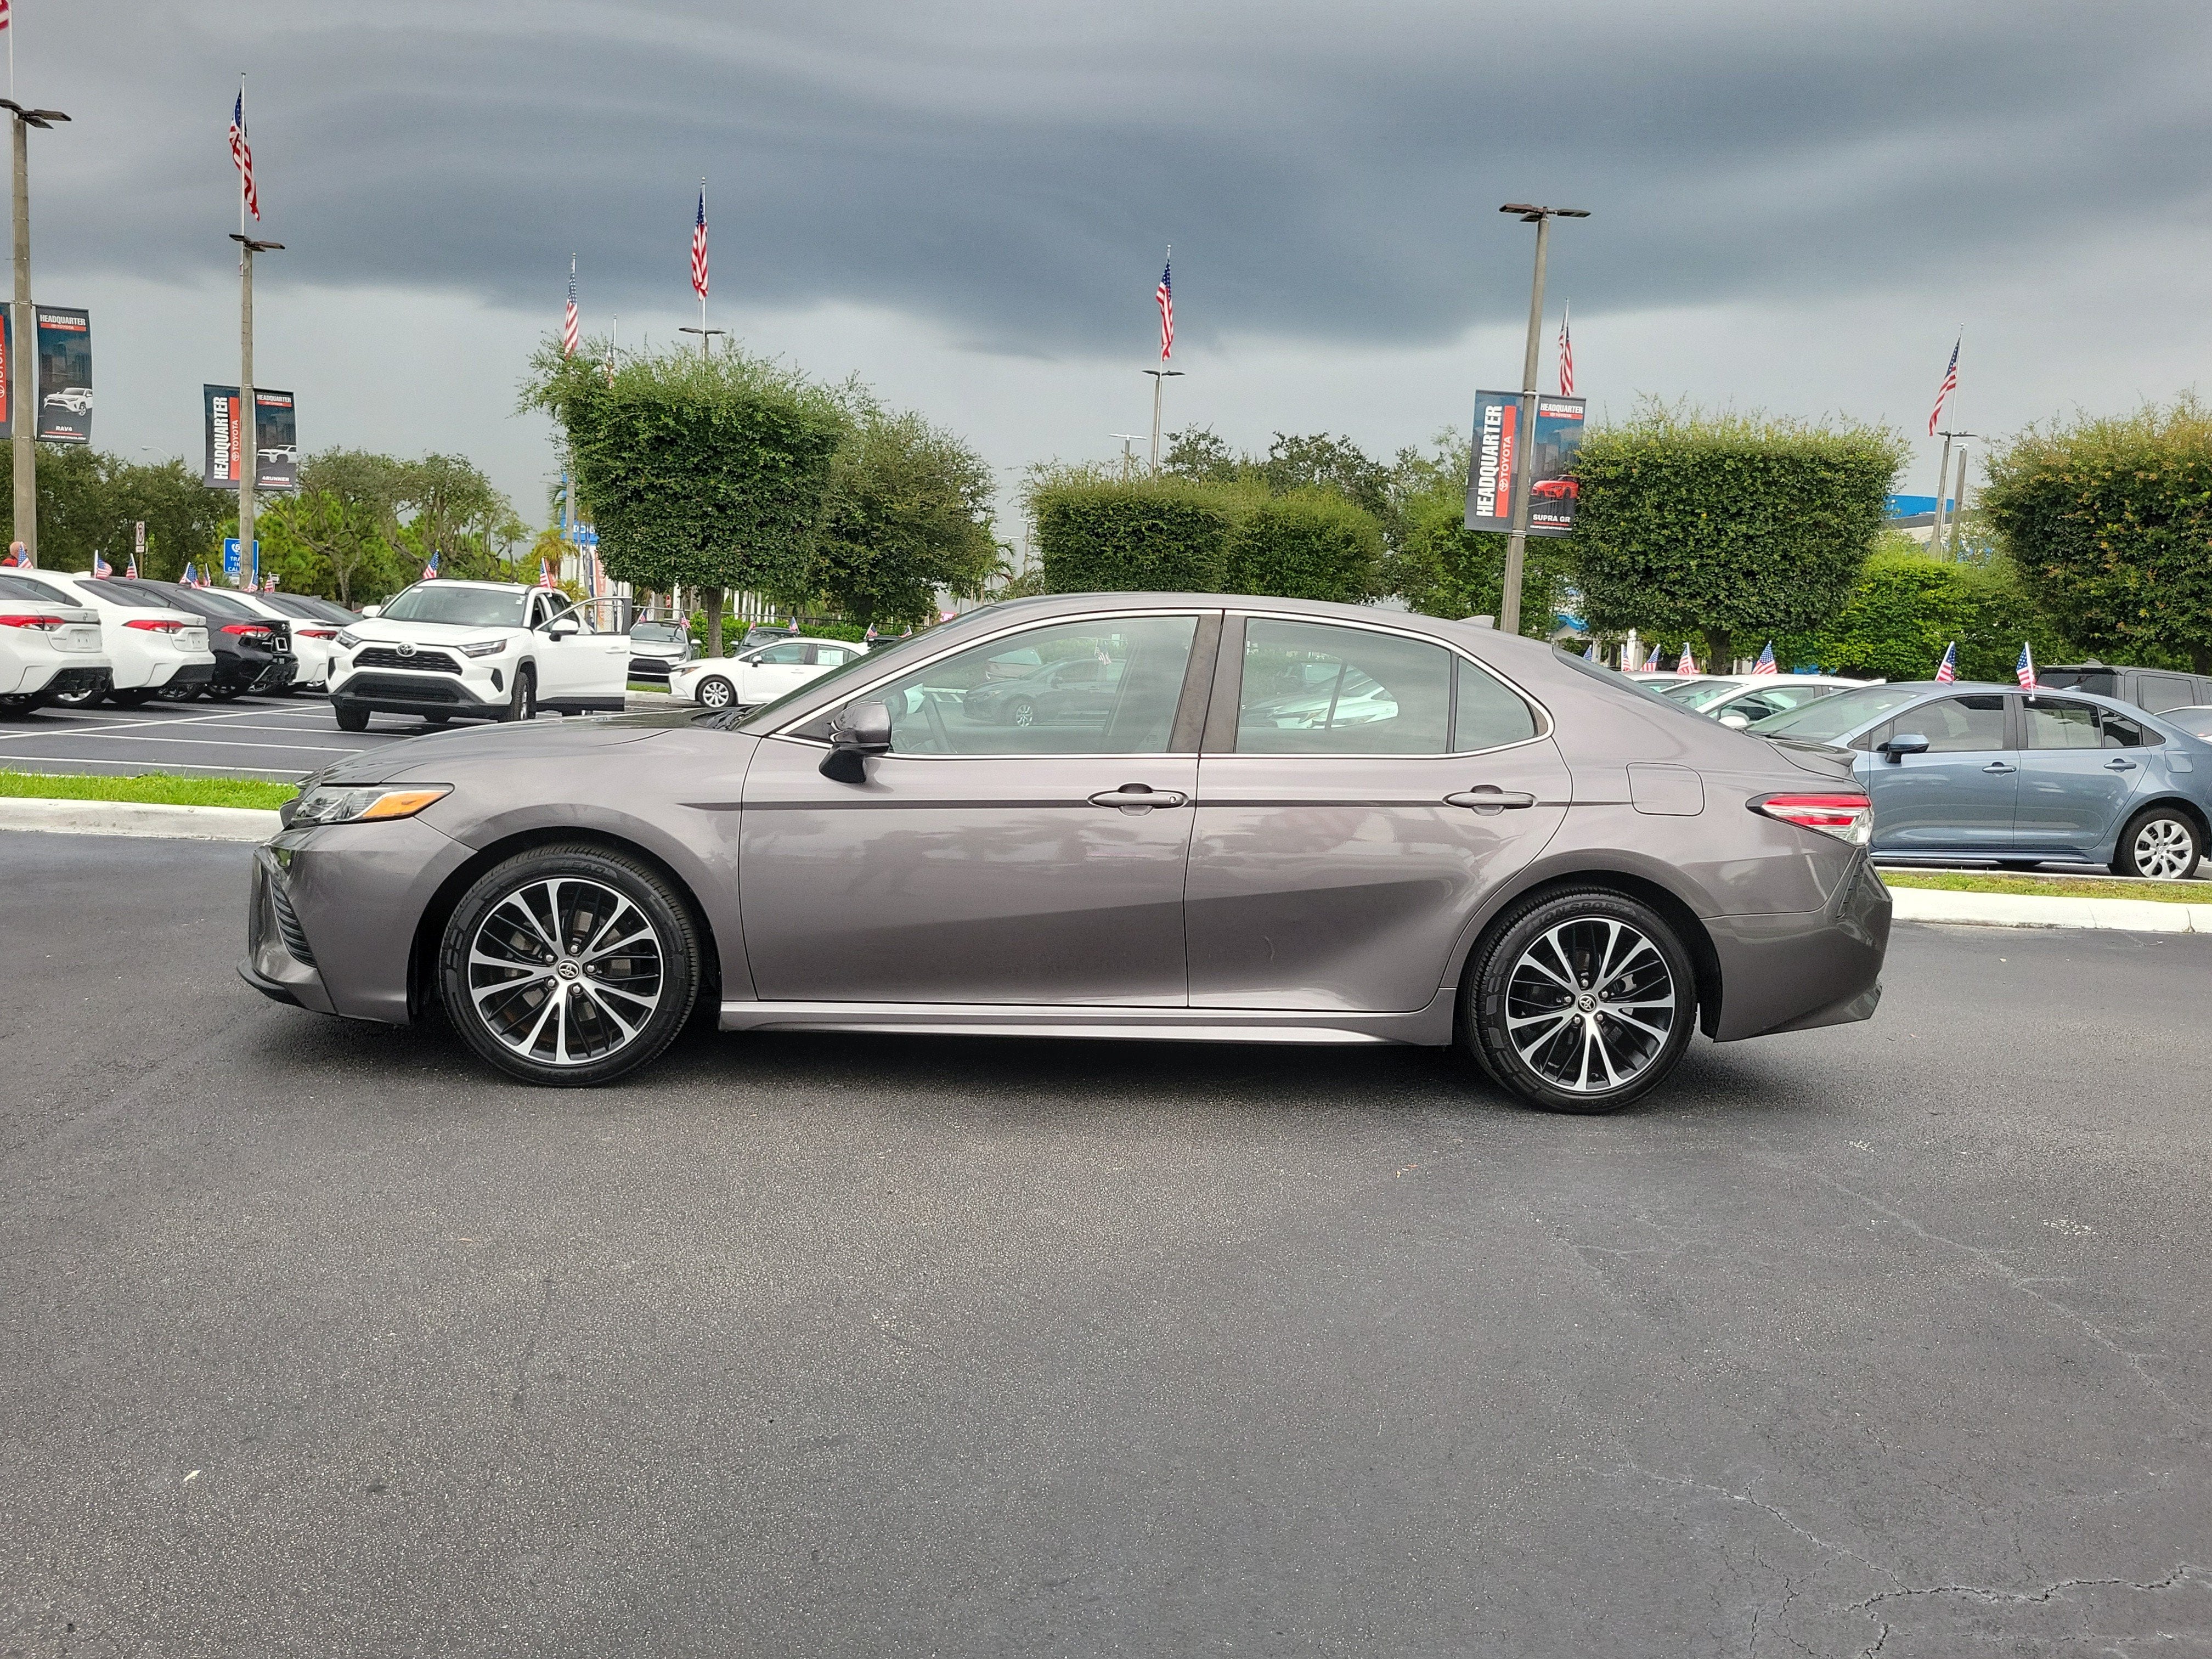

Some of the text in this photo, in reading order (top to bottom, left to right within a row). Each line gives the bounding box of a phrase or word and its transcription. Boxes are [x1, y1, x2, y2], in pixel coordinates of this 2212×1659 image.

[40, 314, 86, 326] HEADQUARTER
[257, 394, 291, 403] HEADQUARTER
[1540, 403, 1583, 415] HEADQUARTER
[213, 397, 230, 480] HEADQUARTER
[1476, 405, 1502, 517] HEADQUARTER
[1500, 436, 1512, 478] TOYOTA
